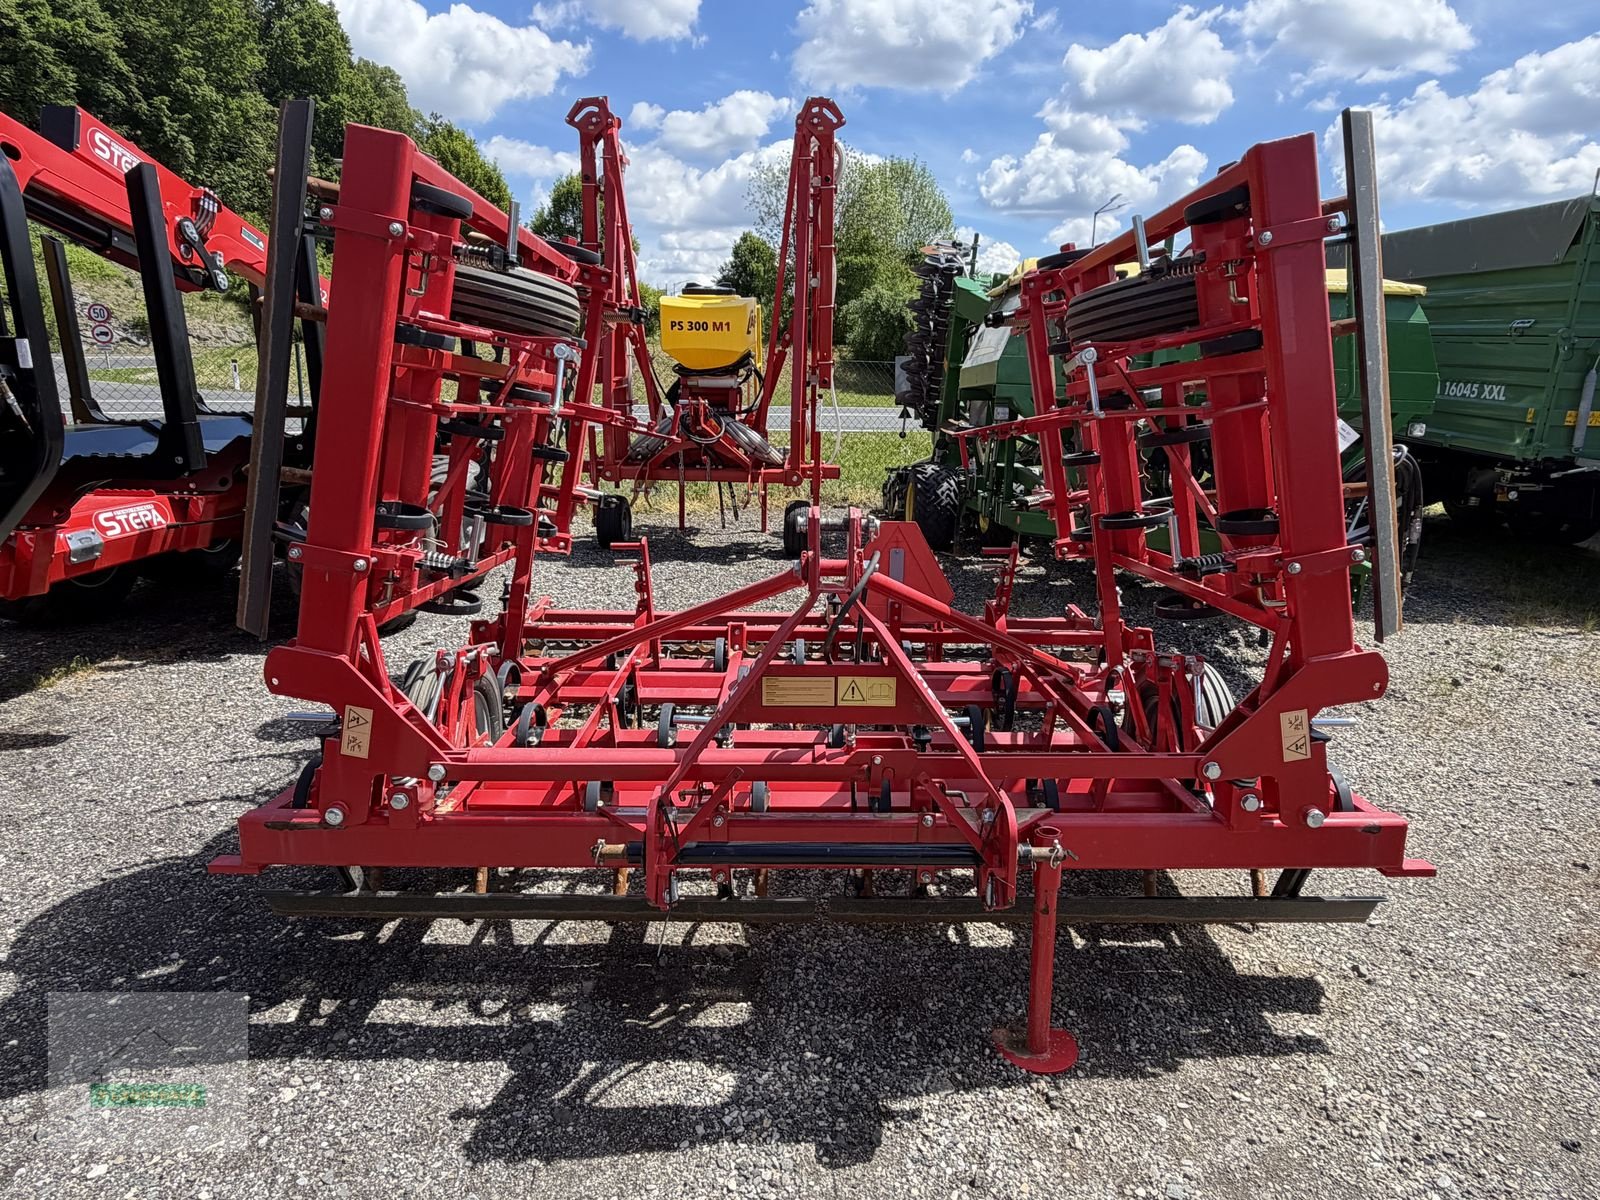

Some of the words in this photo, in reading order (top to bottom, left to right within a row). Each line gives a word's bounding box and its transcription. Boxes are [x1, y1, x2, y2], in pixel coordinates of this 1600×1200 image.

[94, 131, 138, 174] STE
[92, 307, 106, 319] 50
[670, 320, 684, 331] PS
[687, 321, 709, 332] 300
[712, 321, 731, 332] M1
[1444, 381, 1480, 398] 16045
[1480, 384, 1507, 401] XXL
[98, 508, 167, 537] STEPA
